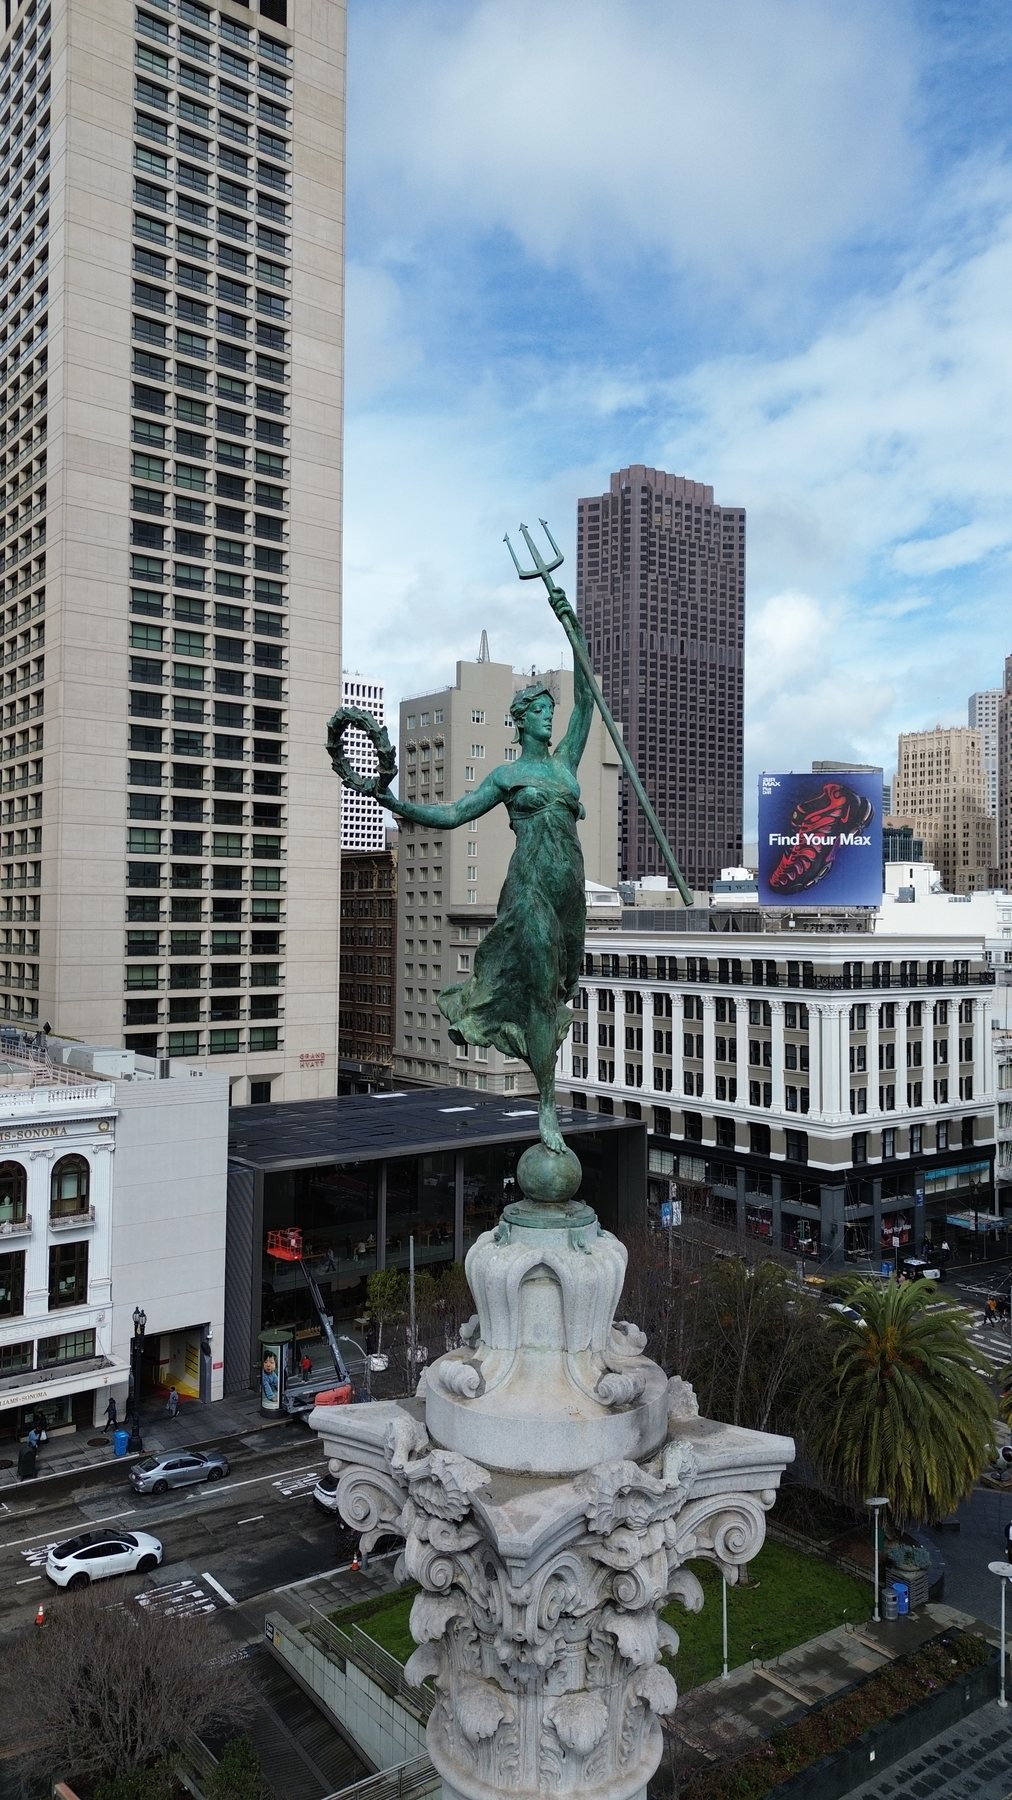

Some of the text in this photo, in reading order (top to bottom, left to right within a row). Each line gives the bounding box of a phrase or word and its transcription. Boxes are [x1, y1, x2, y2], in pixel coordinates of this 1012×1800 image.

[769, 833, 872, 846] Find Your Max
